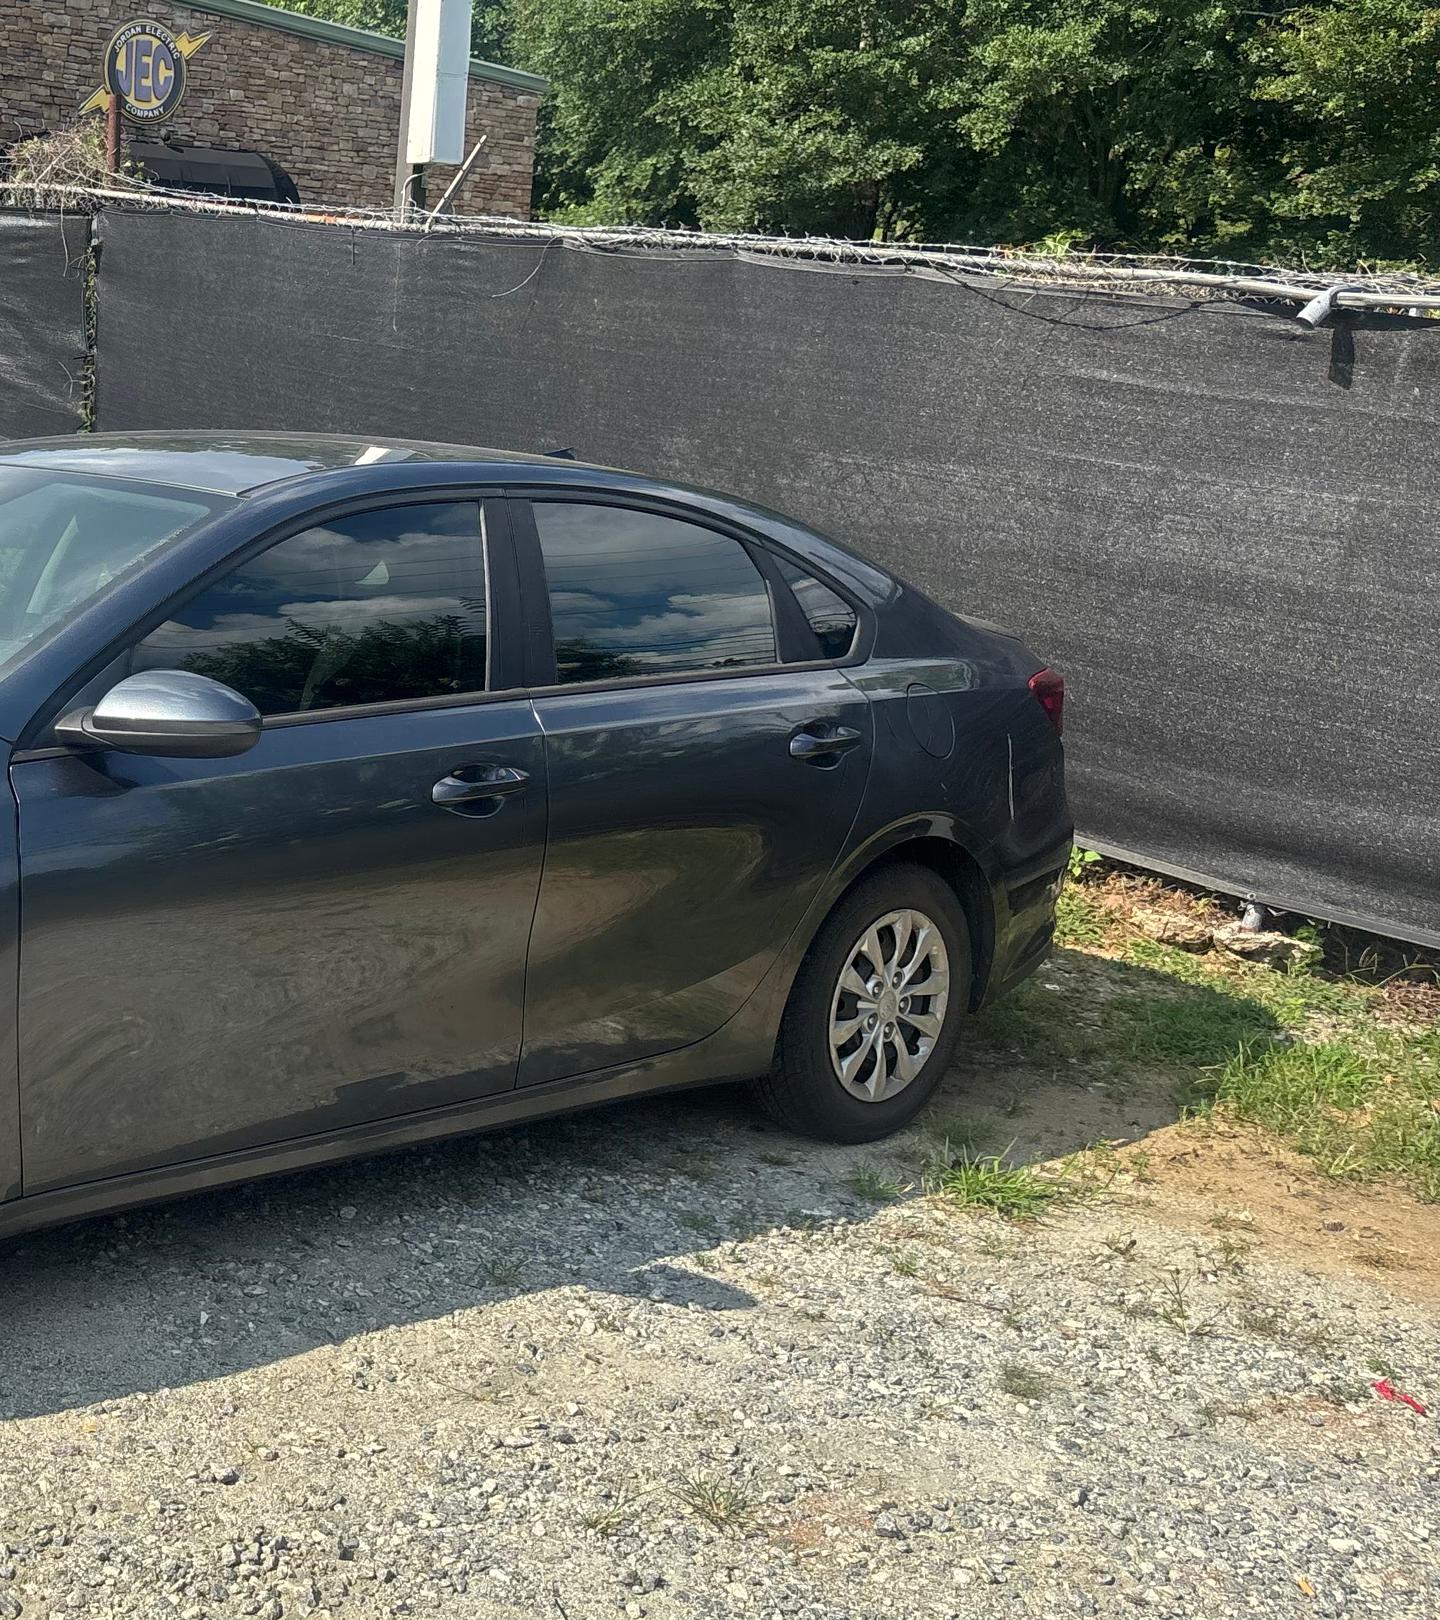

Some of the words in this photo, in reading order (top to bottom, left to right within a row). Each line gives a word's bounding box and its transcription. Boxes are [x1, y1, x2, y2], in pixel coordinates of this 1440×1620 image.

[114, 25, 142, 53] JORDAN
[145, 25, 180, 60] ELECTRIC
[115, 39, 174, 103] JEC
[125, 103, 164, 118] COMPANY
